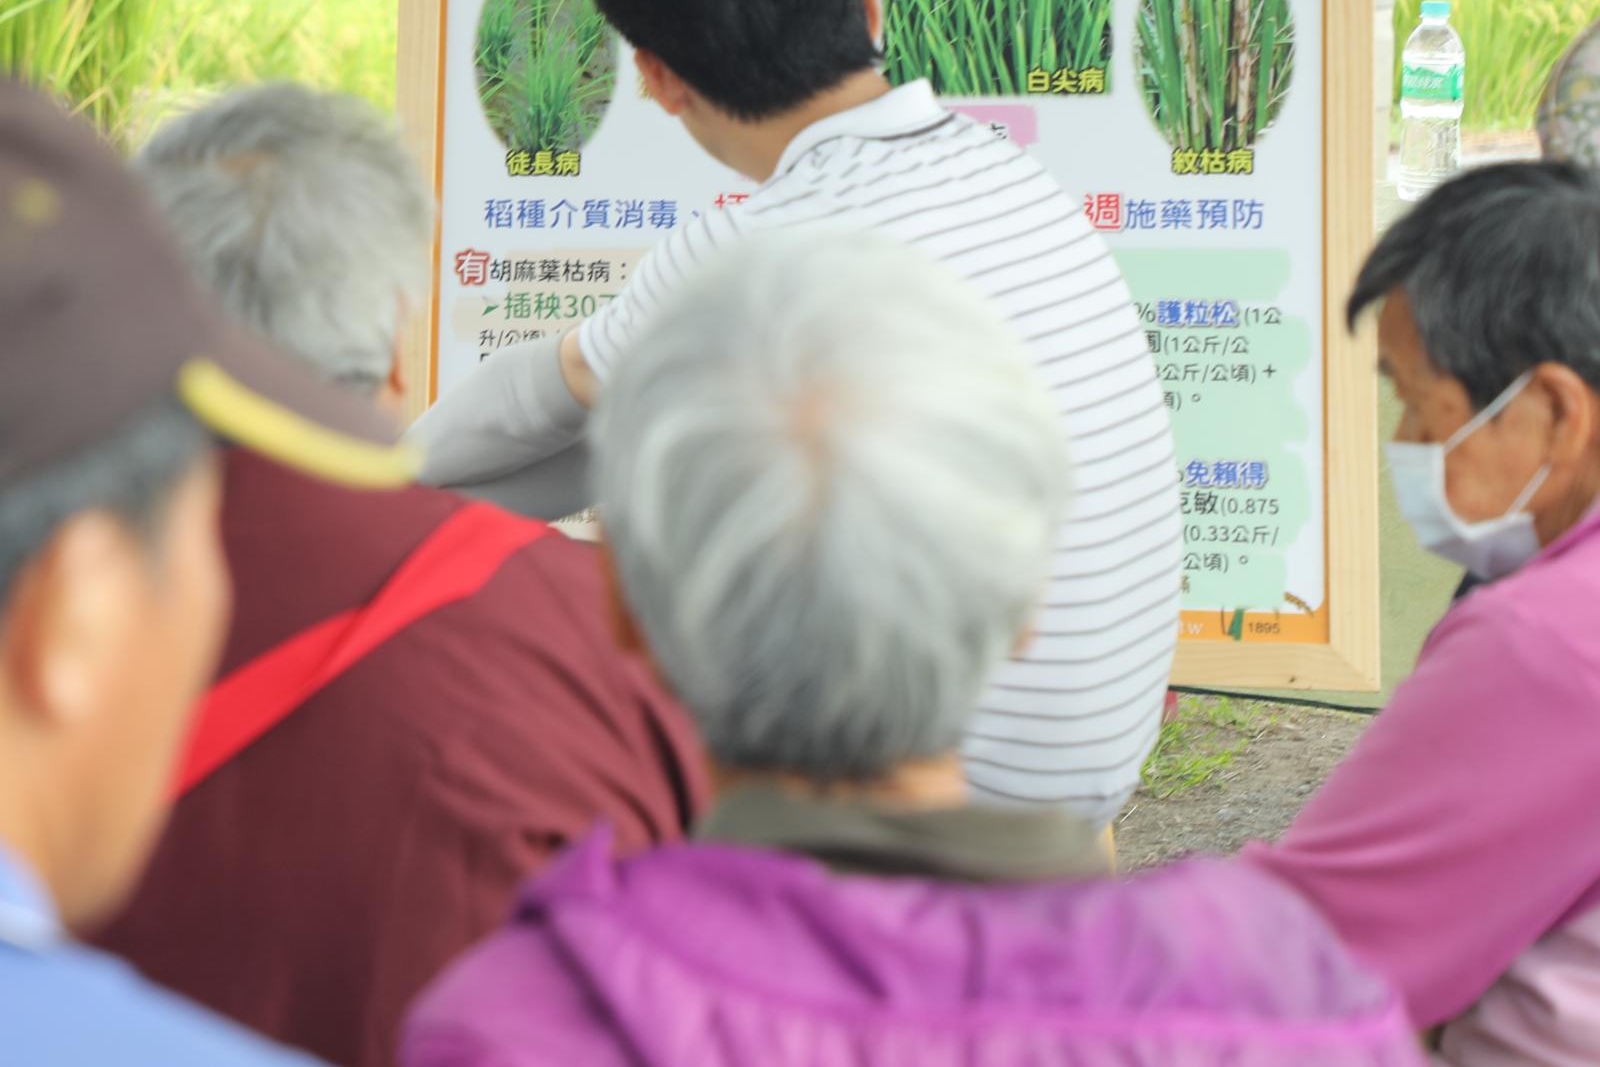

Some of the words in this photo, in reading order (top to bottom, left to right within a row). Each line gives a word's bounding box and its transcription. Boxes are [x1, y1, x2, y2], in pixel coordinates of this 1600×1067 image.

[1027, 66, 1105, 95] 白尖病
[506, 149, 582, 177] 徒長病
[1171, 148, 1255, 176] 紋枯病
[484, 193, 751, 230] 稻種介質消毒、
[504, 290, 617, 321] 插秧30
[1178, 460, 1268, 489] 免賴得
[1248, 622, 1280, 634] 1895
